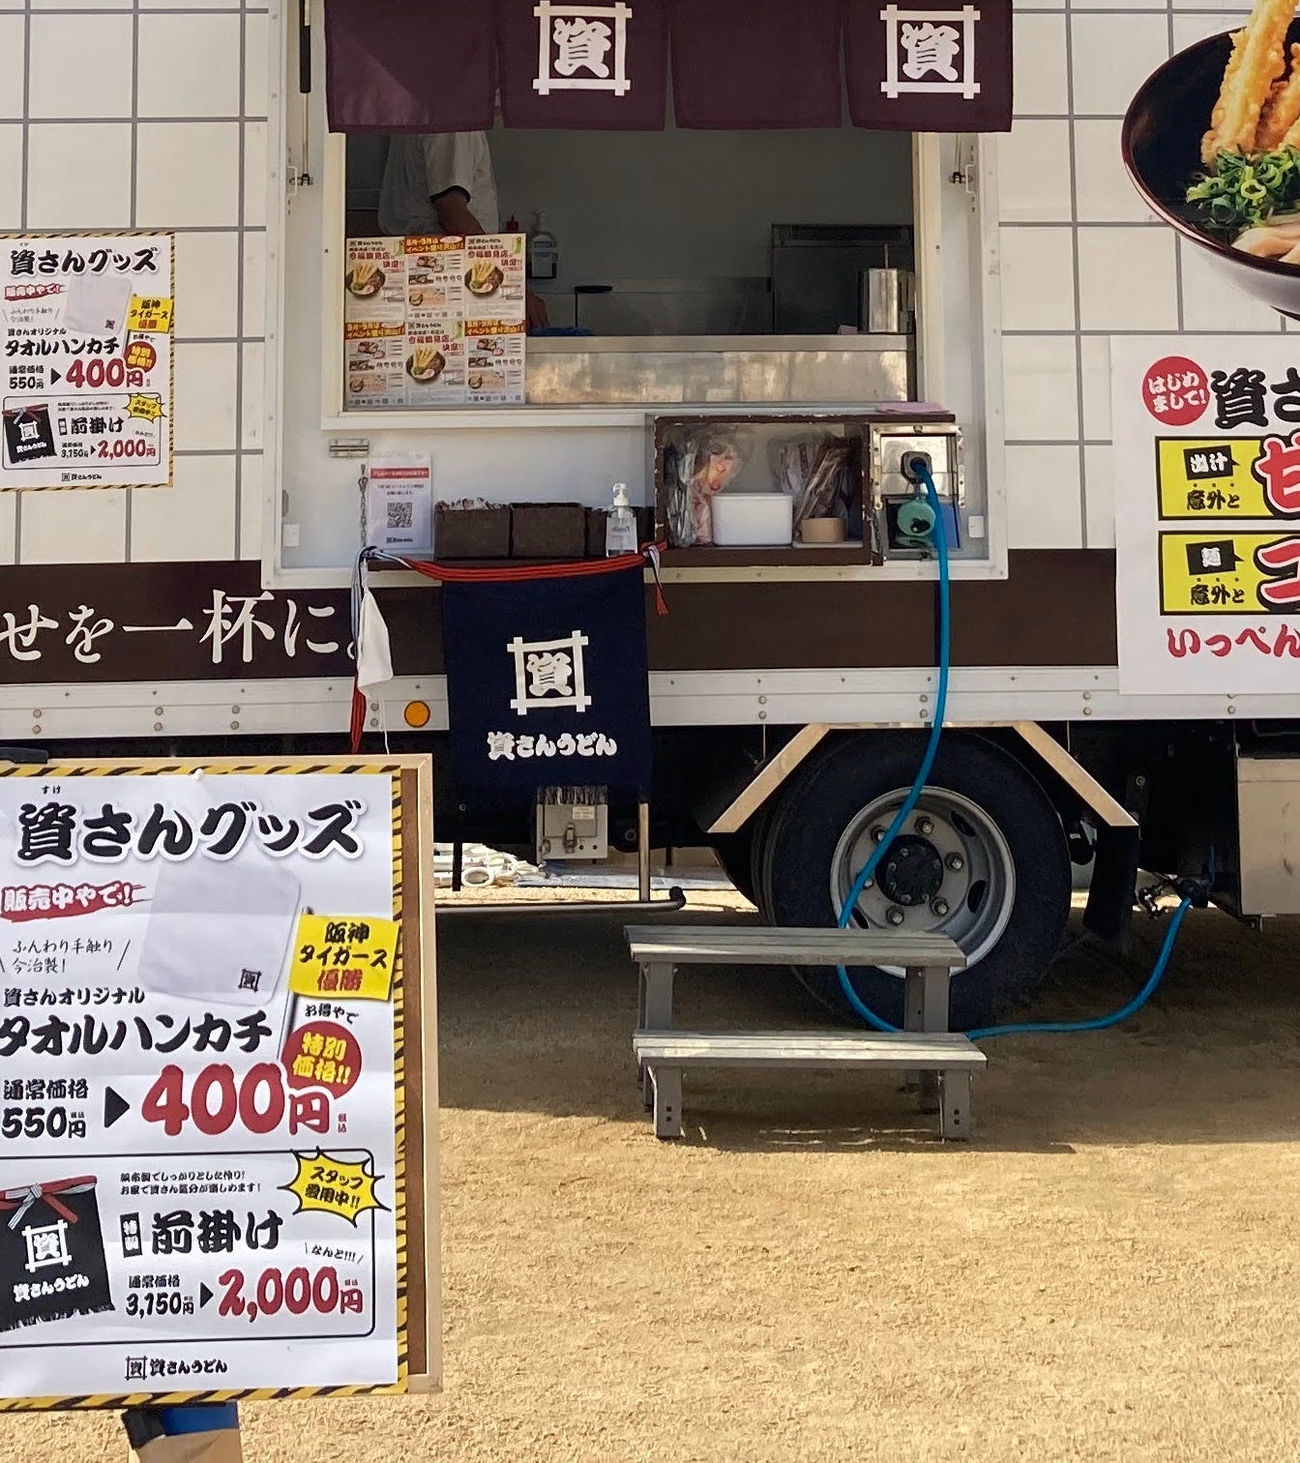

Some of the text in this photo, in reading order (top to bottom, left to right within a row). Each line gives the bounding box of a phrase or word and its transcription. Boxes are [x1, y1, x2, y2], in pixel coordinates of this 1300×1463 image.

[10, 246, 158, 276] 資さんグッズ
[130, 308, 169, 320] タイガース
[7, 327, 68, 337] 資さんオリジナル
[5, 337, 120, 357] タオルハンカチ
[9, 358, 144, 389] 550円 400円
[1147, 369, 1200, 392] はじめ
[1151, 388, 1208, 413] まして!
[71, 417, 125, 435] 前掛け
[97, 439, 156, 460] 2,000円
[1189, 452, 1226, 475] 出汁
[1186, 488, 1242, 511] 意外と
[1200, 546, 1222, 569] 麺
[1190, 583, 1245, 607] 意外と
[486, 731, 618, 763] 資さんうどん
[41, 784, 62, 796] すけ
[18, 799, 362, 862] 資さんグッズ
[4, 882, 132, 913] 販売中やで!
[324, 921, 370, 944] 阪神
[12, 937, 113, 955] ふんわり手触り
[299, 944, 389, 970] タイガース
[317, 967, 363, 992] 優勝
[4, 986, 146, 1008] 資さんオリジナル
[304, 1002, 360, 1025] お得やで
[301, 1030, 348, 1061] 特別
[292, 1053, 352, 1086] 価格!!
[3, 1078, 90, 1101] 通常価格
[1, 1106, 88, 1141] 550円
[141, 1062, 331, 1138] 400円
[309, 1165, 364, 1190] スタッフ
[151, 1209, 284, 1255] 前掛け
[12, 1272, 90, 1304] 資さんうどん
[128, 1274, 182, 1289] 通常価格
[125, 1266, 364, 1323] 3,150円 2,000円
[148, 1357, 229, 1376] 資さんうどん
